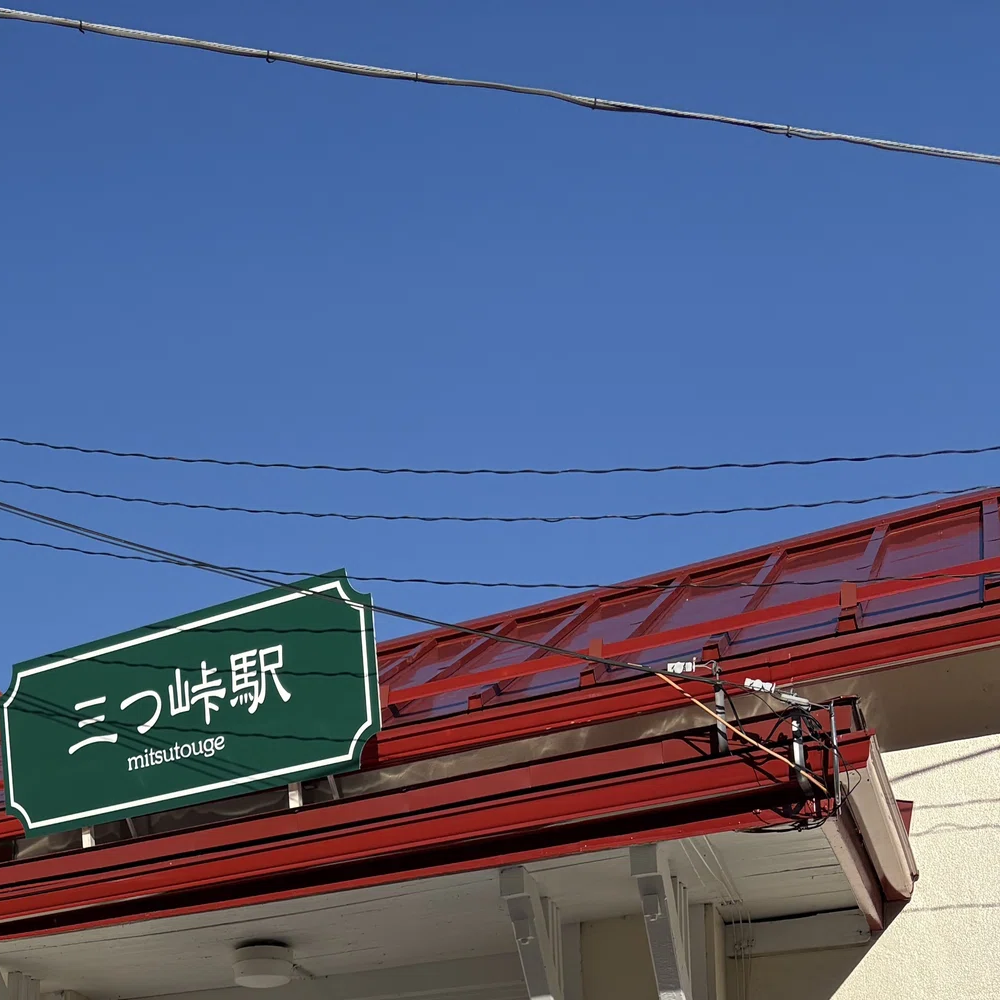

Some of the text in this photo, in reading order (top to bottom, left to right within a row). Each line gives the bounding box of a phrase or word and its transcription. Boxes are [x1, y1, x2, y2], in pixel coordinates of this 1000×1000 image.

[68, 643, 292, 755] 三つ峠駅
[127, 734, 226, 772] mitsutouge
